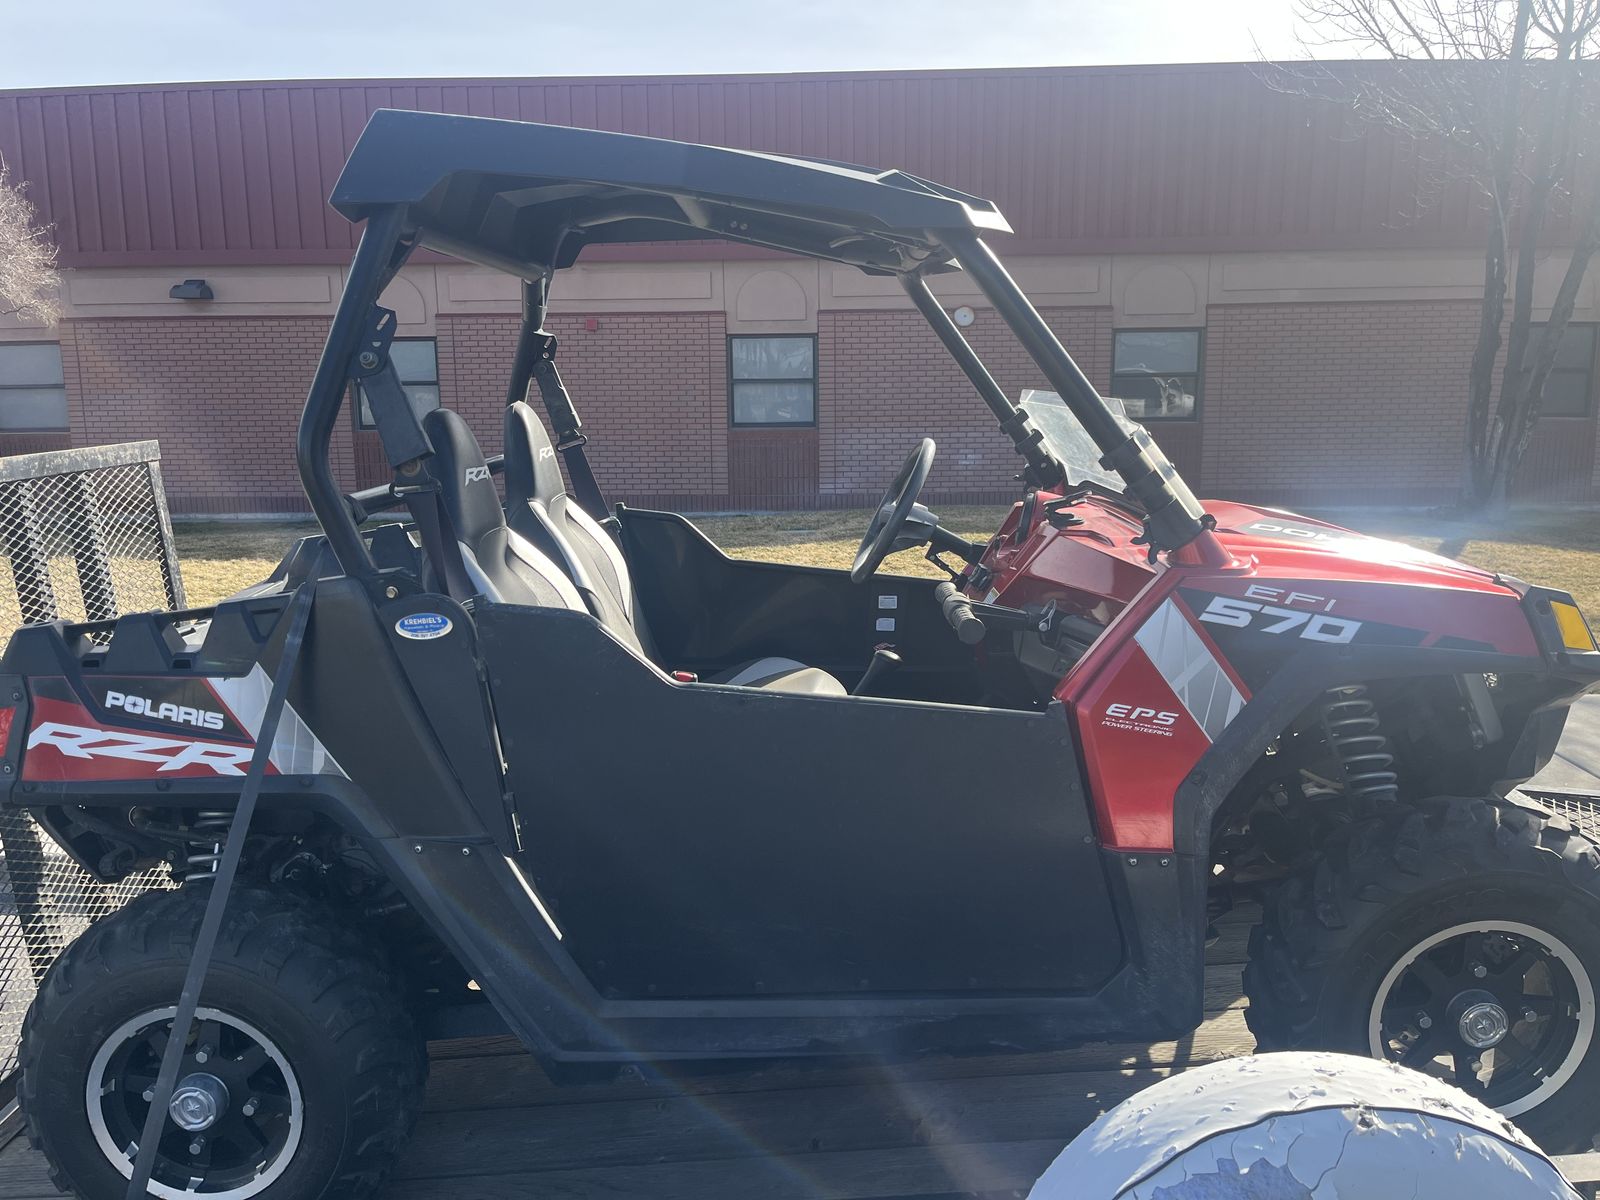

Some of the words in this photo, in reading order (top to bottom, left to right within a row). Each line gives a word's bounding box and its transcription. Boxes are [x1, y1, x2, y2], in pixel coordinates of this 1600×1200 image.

[540, 445, 555, 462] RZ
[1244, 584, 1337, 612] EFI
[1198, 596, 1362, 643] 570
[105, 690, 224, 730] POLARIS
[1105, 703, 1179, 725] EPS
[1101, 720, 1132, 730] POWER
[1134, 726, 1173, 737] STEERING
[27, 721, 255, 777] RZR
